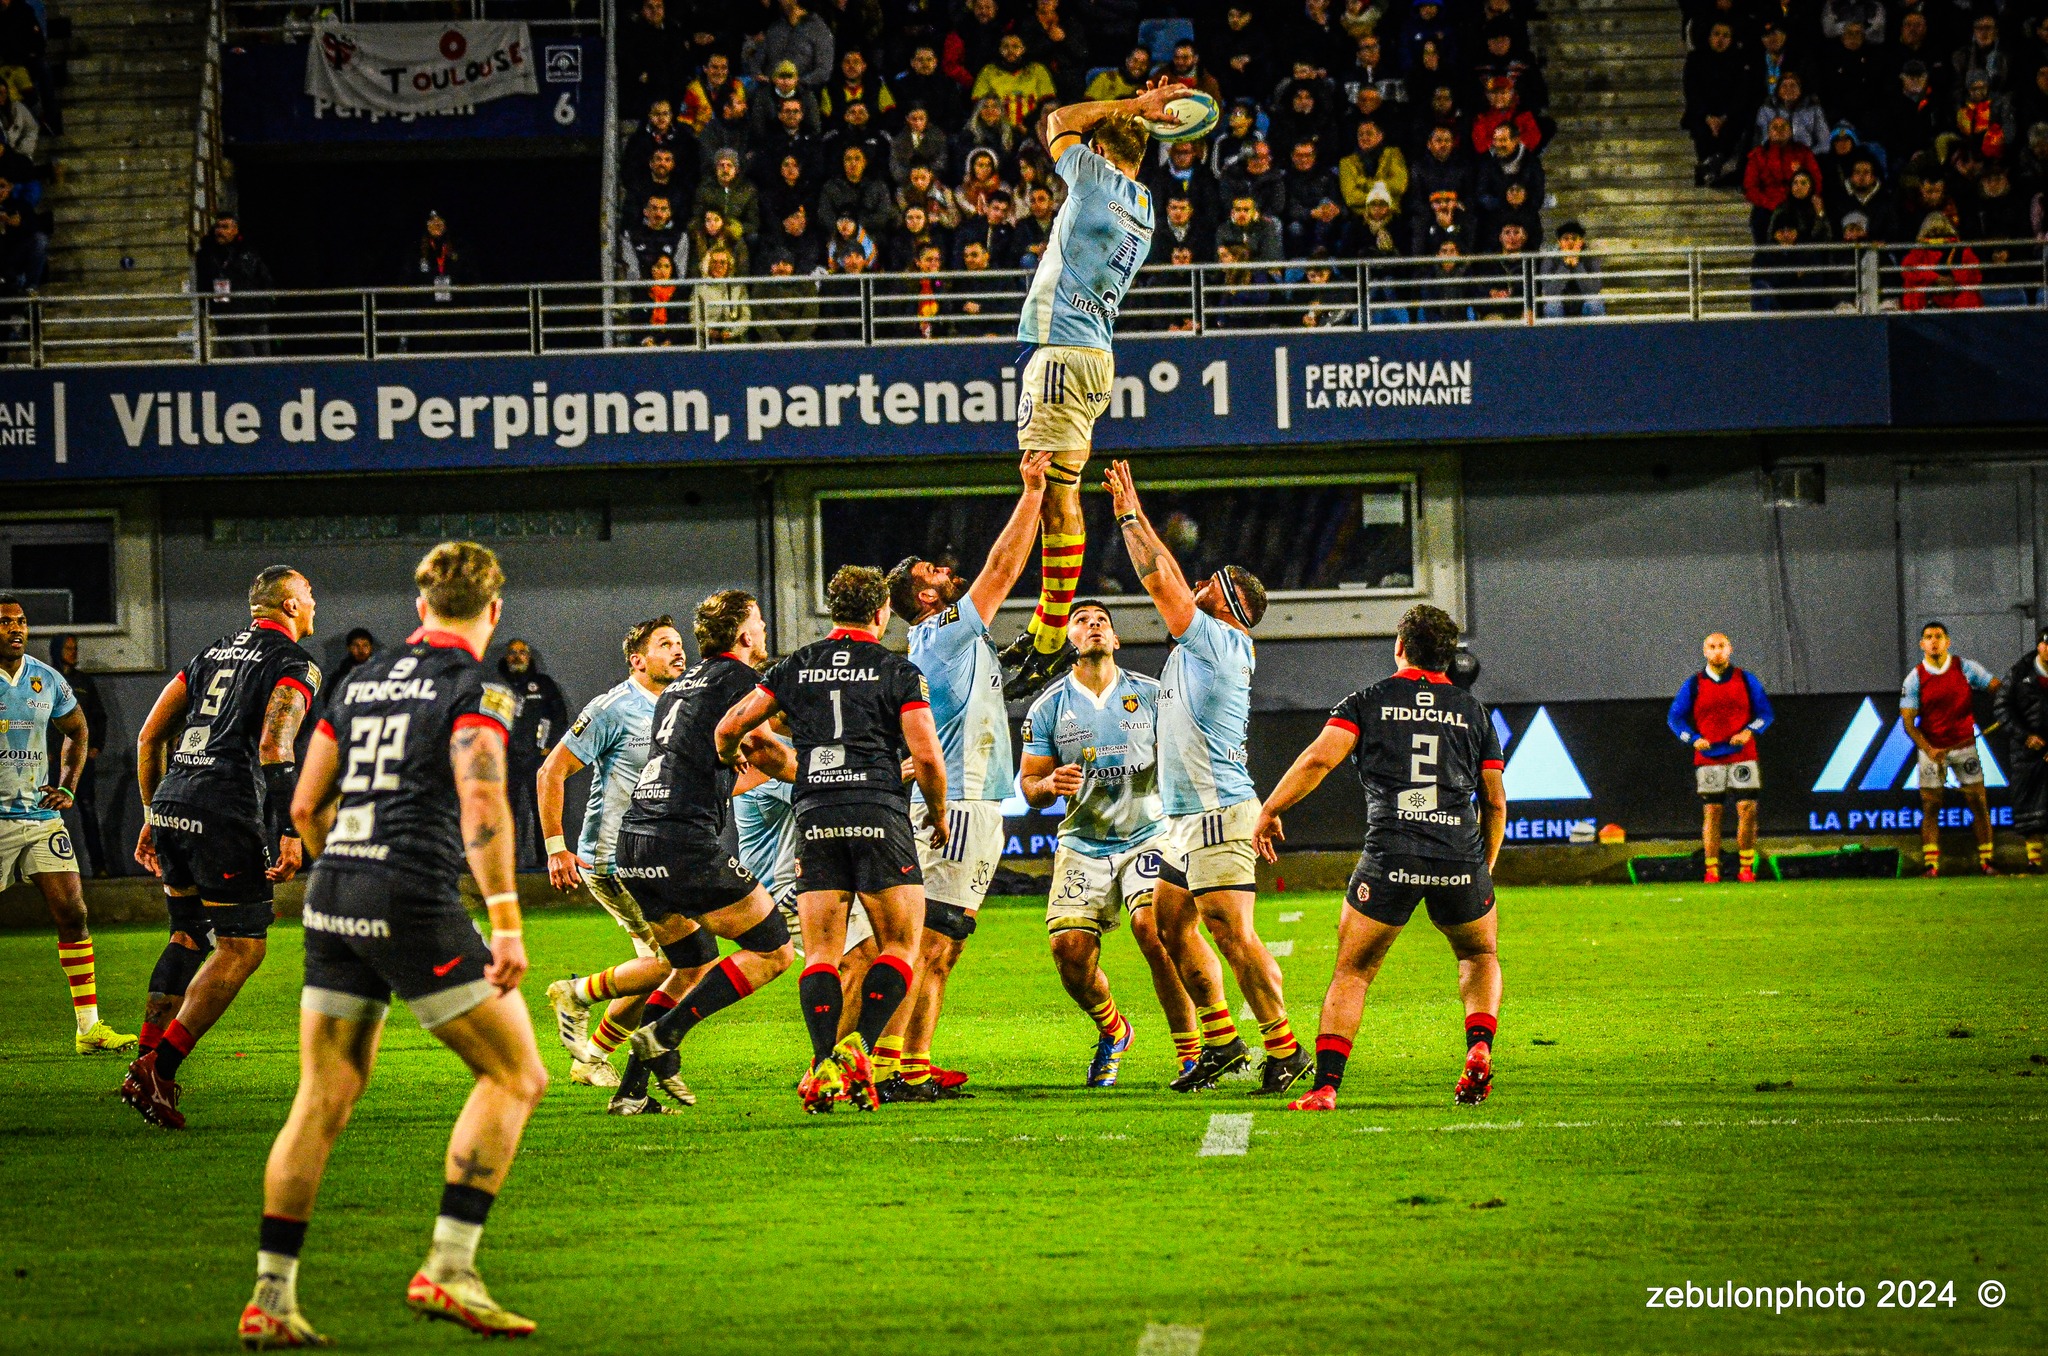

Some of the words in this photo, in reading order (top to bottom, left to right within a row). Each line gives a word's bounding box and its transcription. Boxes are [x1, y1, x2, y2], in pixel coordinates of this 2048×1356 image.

[380, 41, 524, 95] TOULOUSE
[553, 91, 577, 127] 6
[1304, 356, 1472, 390] PERPIGNAN
[110, 390, 262, 447] Ville
[279, 387, 358, 443] de
[376, 380, 730, 450] Perpignan,
[746, 366, 1017, 441] partenai
[1202, 360, 1229, 416] 1
[1305, 390, 1330, 409] LA
[1336, 386, 1472, 408] RAYONNANTE
[0, 427, 37, 446] NTE
[798, 668, 880, 684] FIDUCIAL
[200, 668, 235, 717] 5
[655, 697, 684, 746] 4
[829, 689, 844, 740] 1
[1380, 706, 1469, 730] FIDUCIAL
[340, 712, 412, 794] 22
[1410, 733, 1439, 783] 2
[807, 772, 867, 784] TOULOUSE
[819, 769, 844, 777] MAIRIE
[1086, 762, 1144, 780] ZODIAC
[150, 807, 204, 834] hausson
[1397, 810, 1461, 826] TOULOUSE
[1808, 810, 1842, 831] LA
[804, 824, 885, 841] chausson
[1001, 834, 1024, 855] A
[1066, 869, 1085, 878] CFA
[1388, 869, 1471, 886] chausson
[302, 903, 391, 939] hausson
